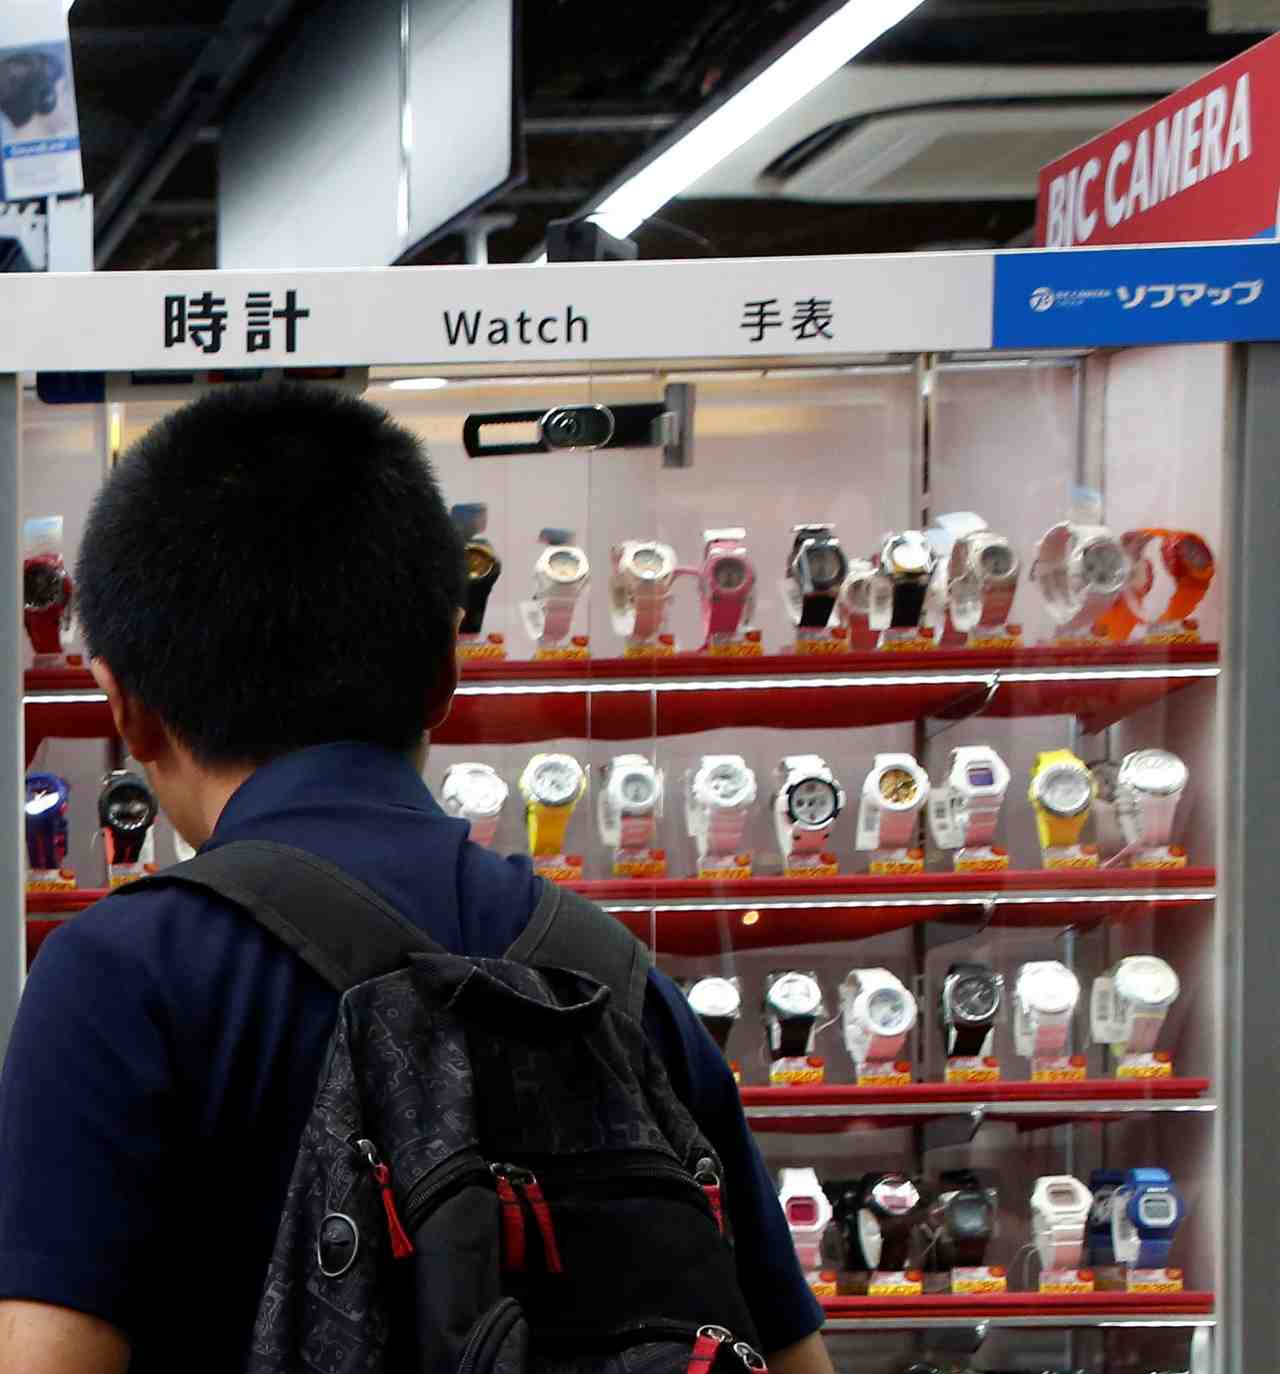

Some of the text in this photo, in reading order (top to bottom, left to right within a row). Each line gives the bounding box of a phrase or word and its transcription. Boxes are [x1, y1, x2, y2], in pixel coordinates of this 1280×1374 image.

[1044, 72, 1251, 248] BIC CAMERA
[1116, 279, 1264, 309] ソフマップ
[164, 290, 310, 354] 時計
[443, 305, 588, 346] Watch
[740, 297, 833, 342] 手表
